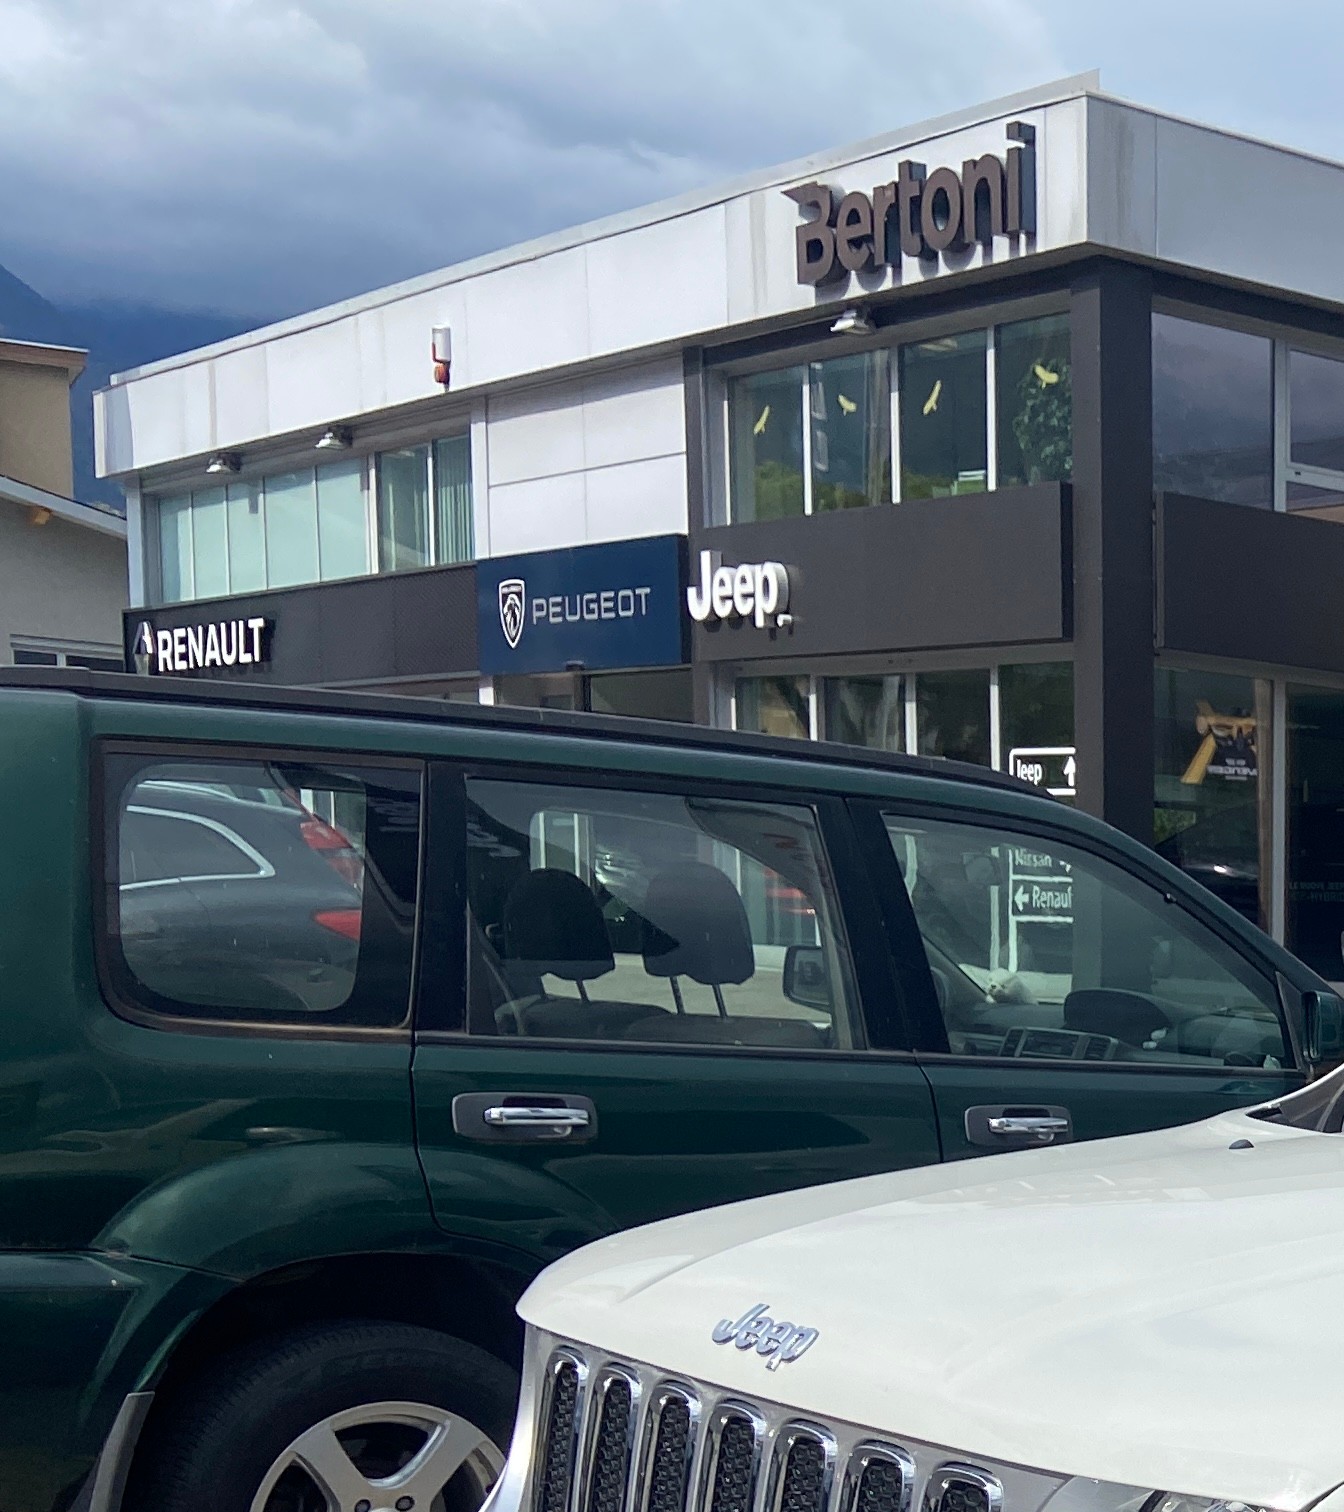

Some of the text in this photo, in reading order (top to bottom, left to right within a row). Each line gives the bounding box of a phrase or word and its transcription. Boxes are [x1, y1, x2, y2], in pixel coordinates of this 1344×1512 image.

[781, 120, 1036, 286] Bertoni
[532, 587, 651, 625] PEUGEOT
[687, 550, 788, 629] Jeep
[157, 617, 265, 672] RENAULT
[711, 1303, 819, 1372] Jeep
